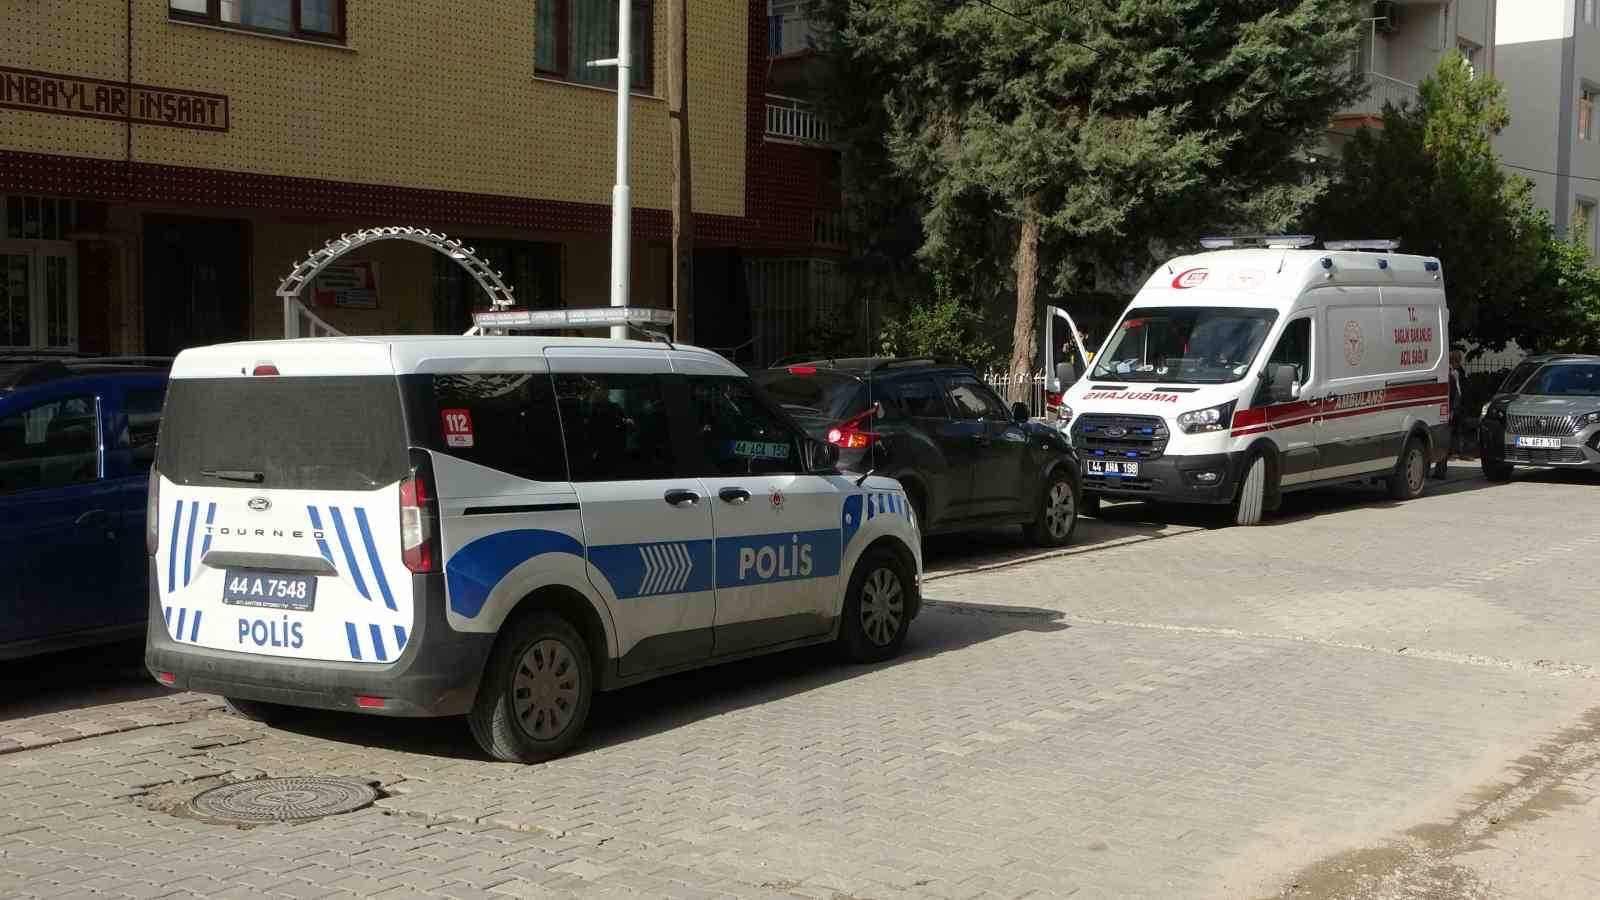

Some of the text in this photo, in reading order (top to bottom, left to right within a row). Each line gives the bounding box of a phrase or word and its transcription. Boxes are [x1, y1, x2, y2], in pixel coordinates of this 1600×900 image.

[446, 414, 469, 432] 112
[1092, 462, 1102, 472] 44
[1105, 462, 1119, 473] AHA
[206, 526, 323, 538] TOURNEO
[739, 534, 813, 580] POLİS
[229, 577, 307, 599] 44 A 7548
[239, 614, 305, 649] POLİS
